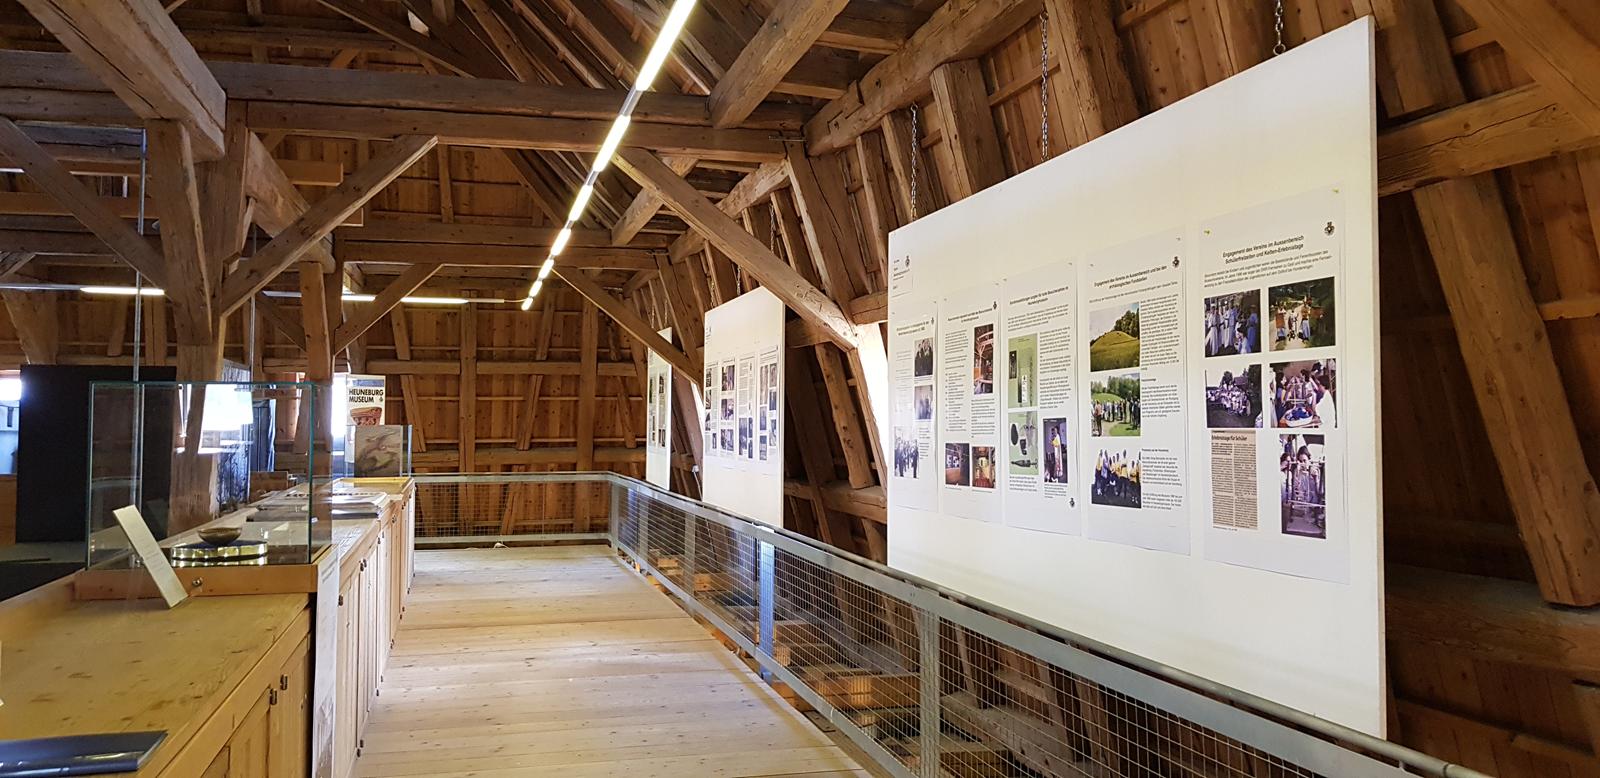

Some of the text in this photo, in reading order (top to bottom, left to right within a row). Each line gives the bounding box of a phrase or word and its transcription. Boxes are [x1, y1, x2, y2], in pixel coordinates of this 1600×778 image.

[1223, 249, 1246, 258] Engagement
[1253, 243, 1268, 251] Vereins
[1274, 235, 1304, 246] Aussenbereich
[349, 388, 384, 396] HEUNEBURG
[349, 395, 375, 403] MUSEUM
